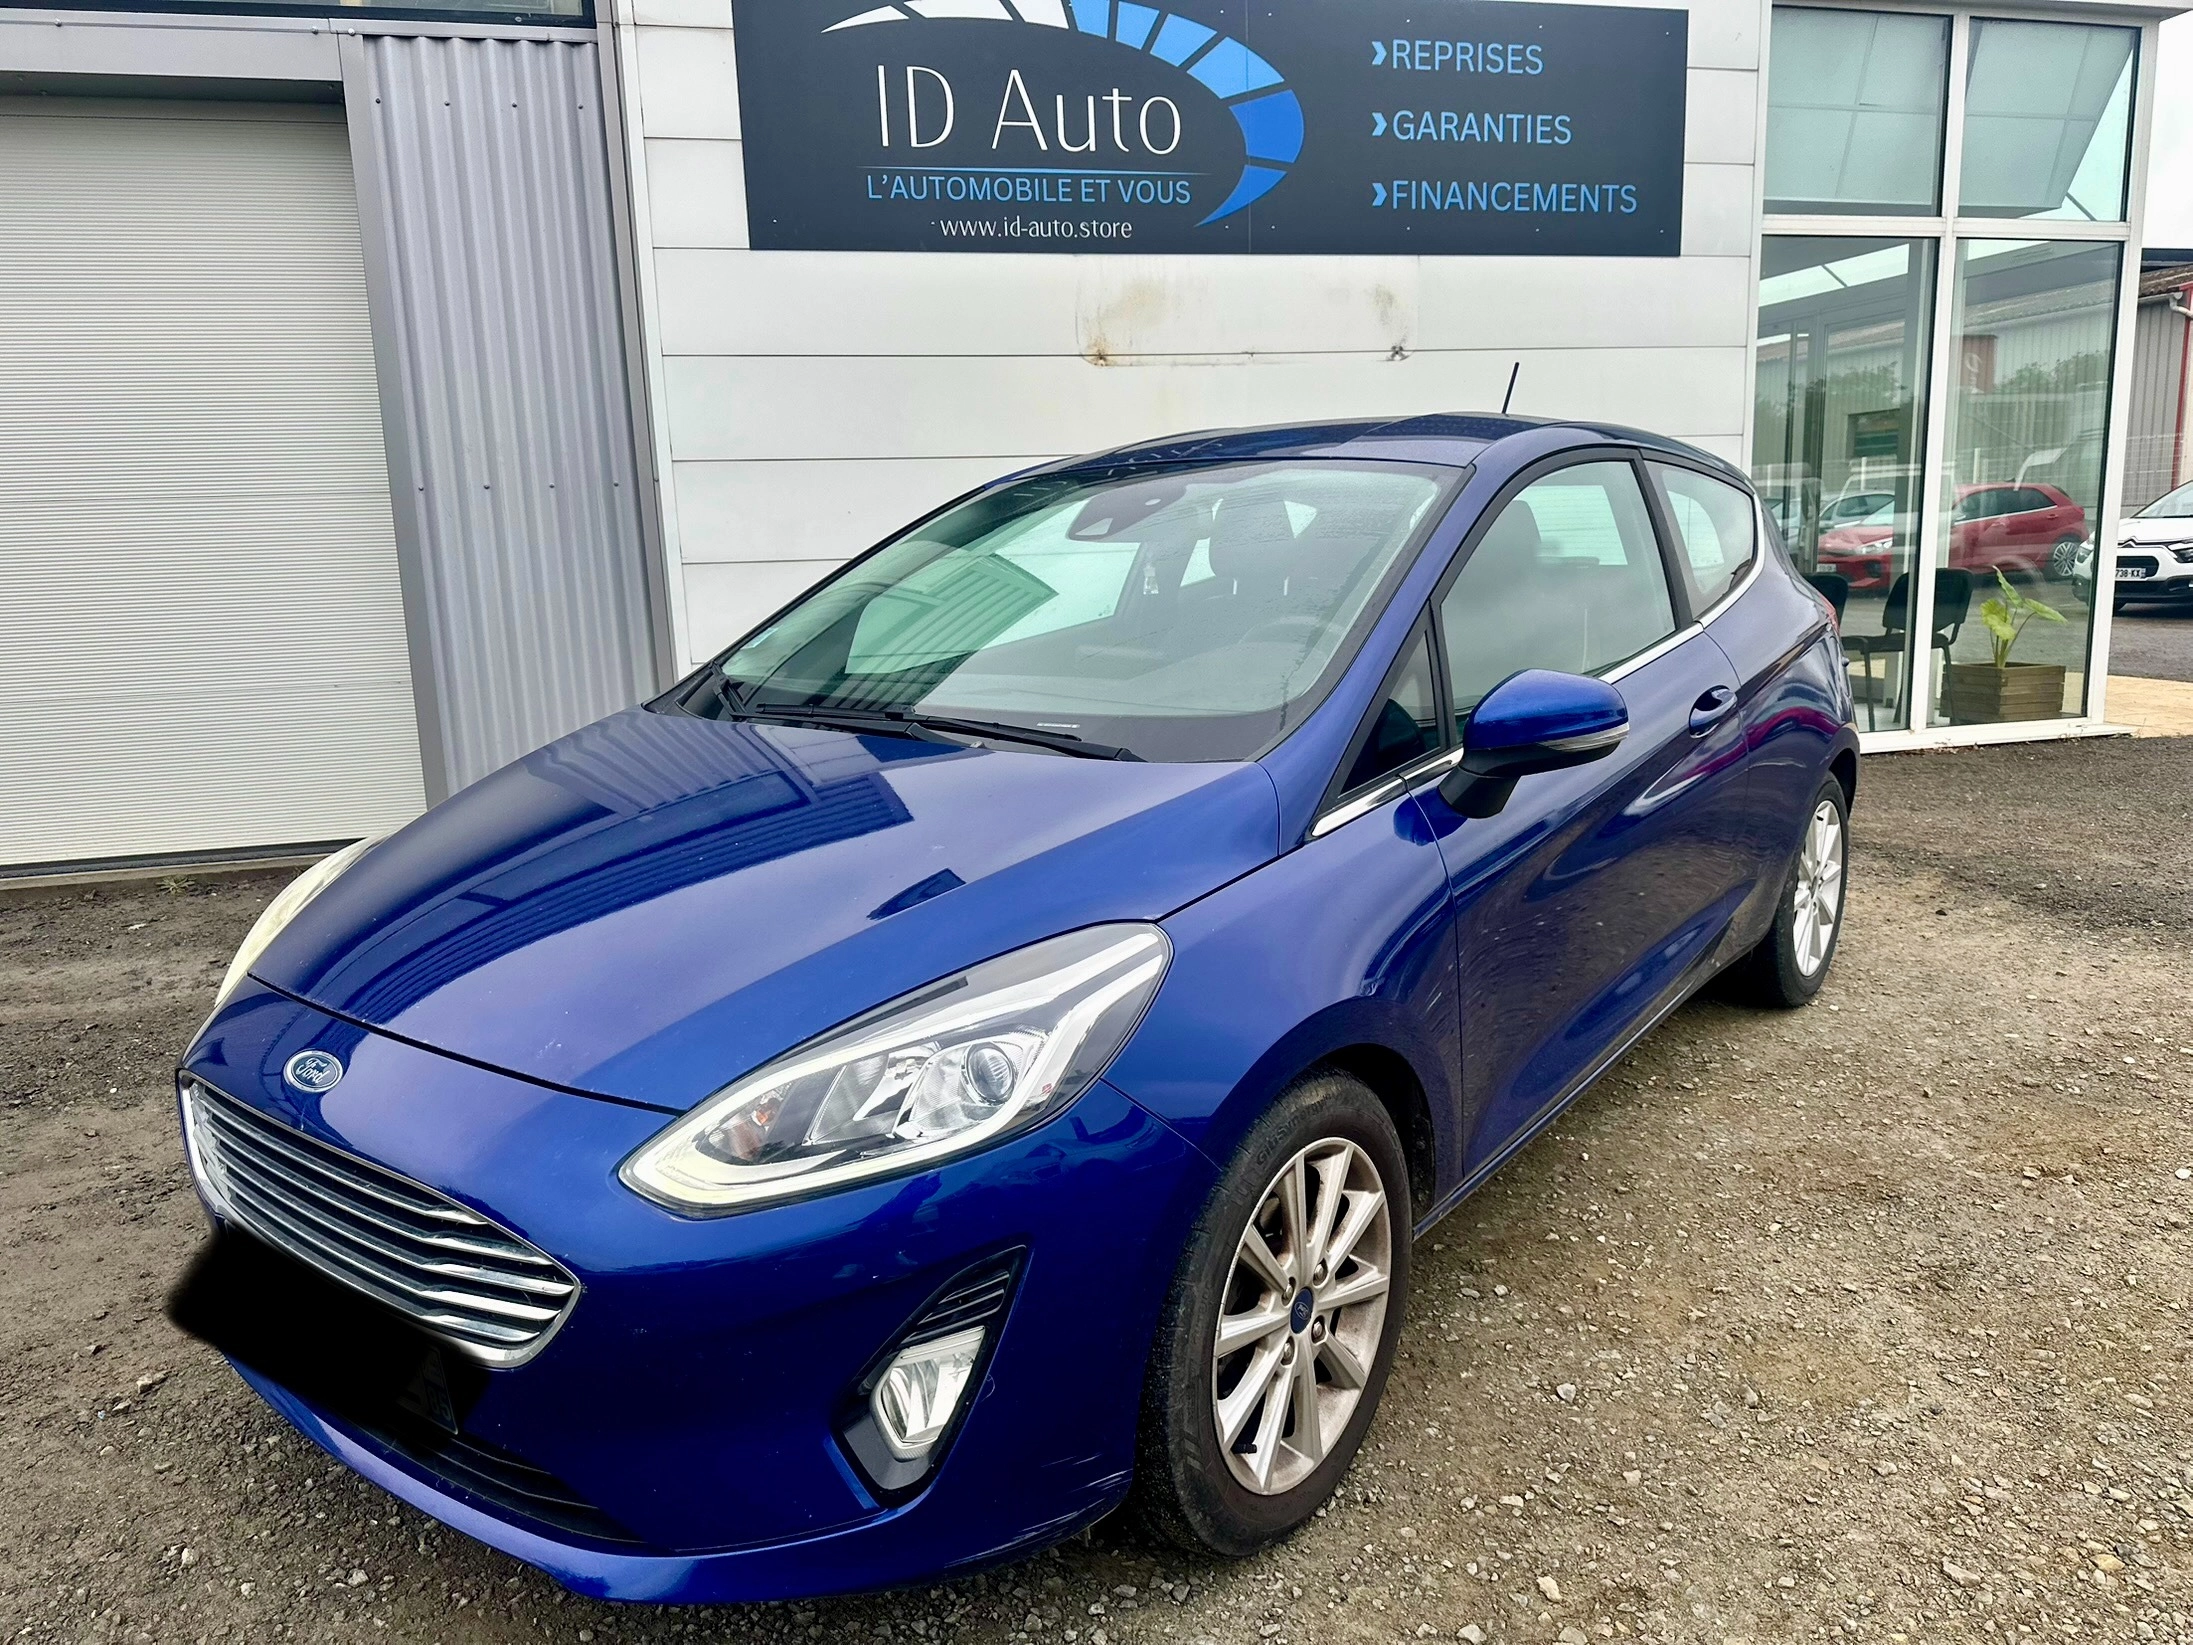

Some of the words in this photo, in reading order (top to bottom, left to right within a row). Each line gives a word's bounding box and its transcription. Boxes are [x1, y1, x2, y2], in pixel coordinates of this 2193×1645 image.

[1391, 40, 1544, 75] REPRISES
[877, 64, 955, 148] ID
[992, 68, 1181, 155] Auto
[1392, 110, 1572, 145] GARANTIES
[1081, 178, 1111, 203] ET
[1117, 179, 1191, 205] VOUS
[1392, 179, 1638, 214] FINANCEMENTS
[940, 215, 1133, 239] www.id-auto.store
[295, 1057, 330, 1084] Ford
